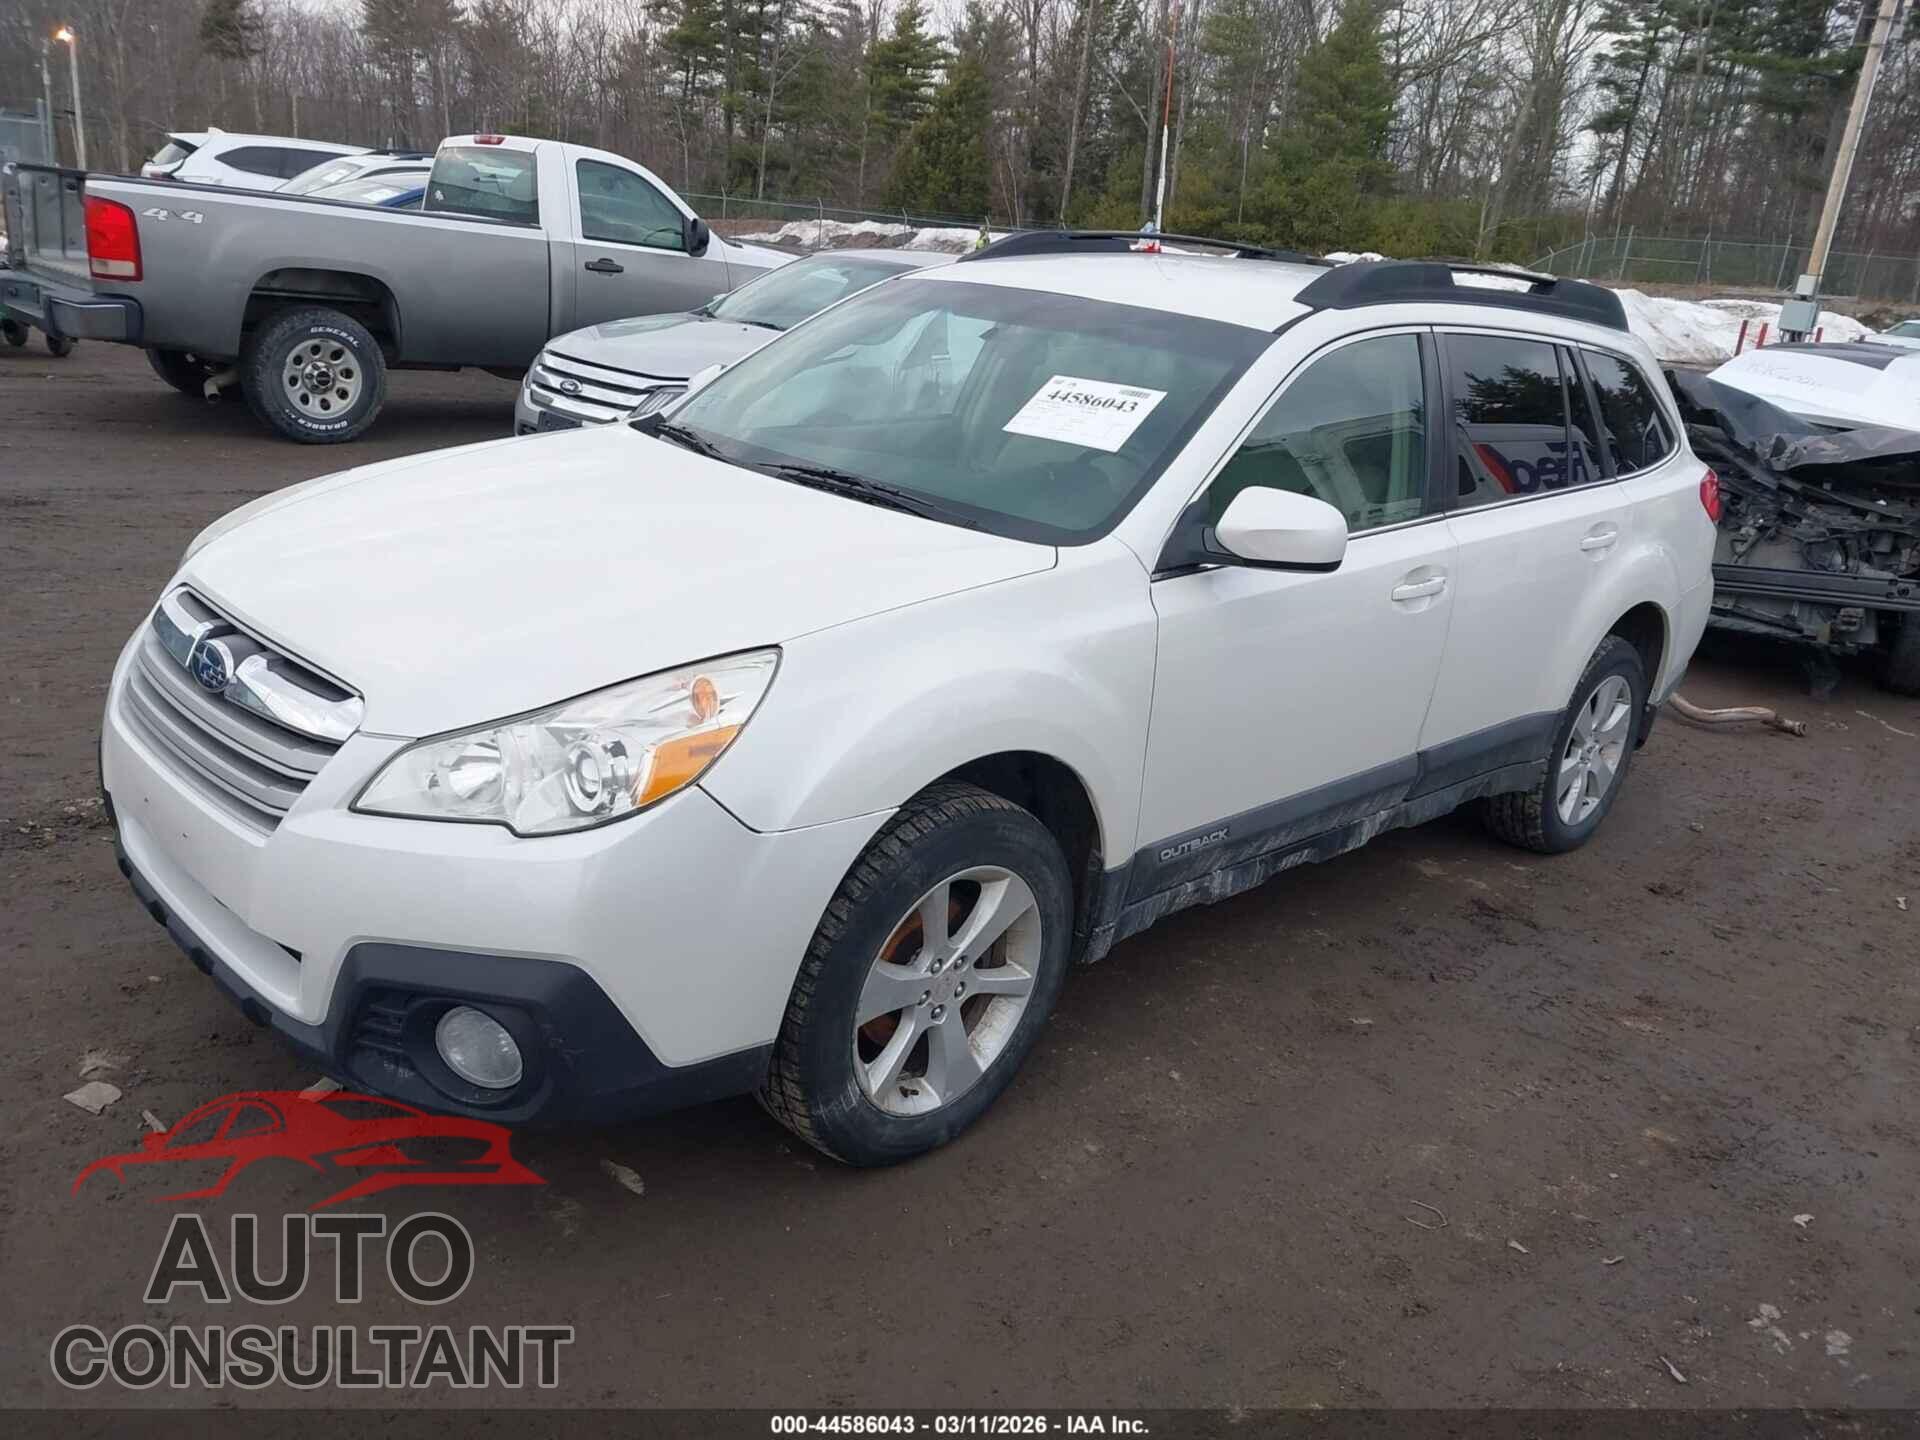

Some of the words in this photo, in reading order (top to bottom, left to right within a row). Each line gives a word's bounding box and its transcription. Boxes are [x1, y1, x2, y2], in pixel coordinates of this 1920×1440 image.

[310, 326, 361, 348] GENERAL
[1047, 389, 1139, 414] 44586043
[1159, 828, 1230, 861] OUTBACK
